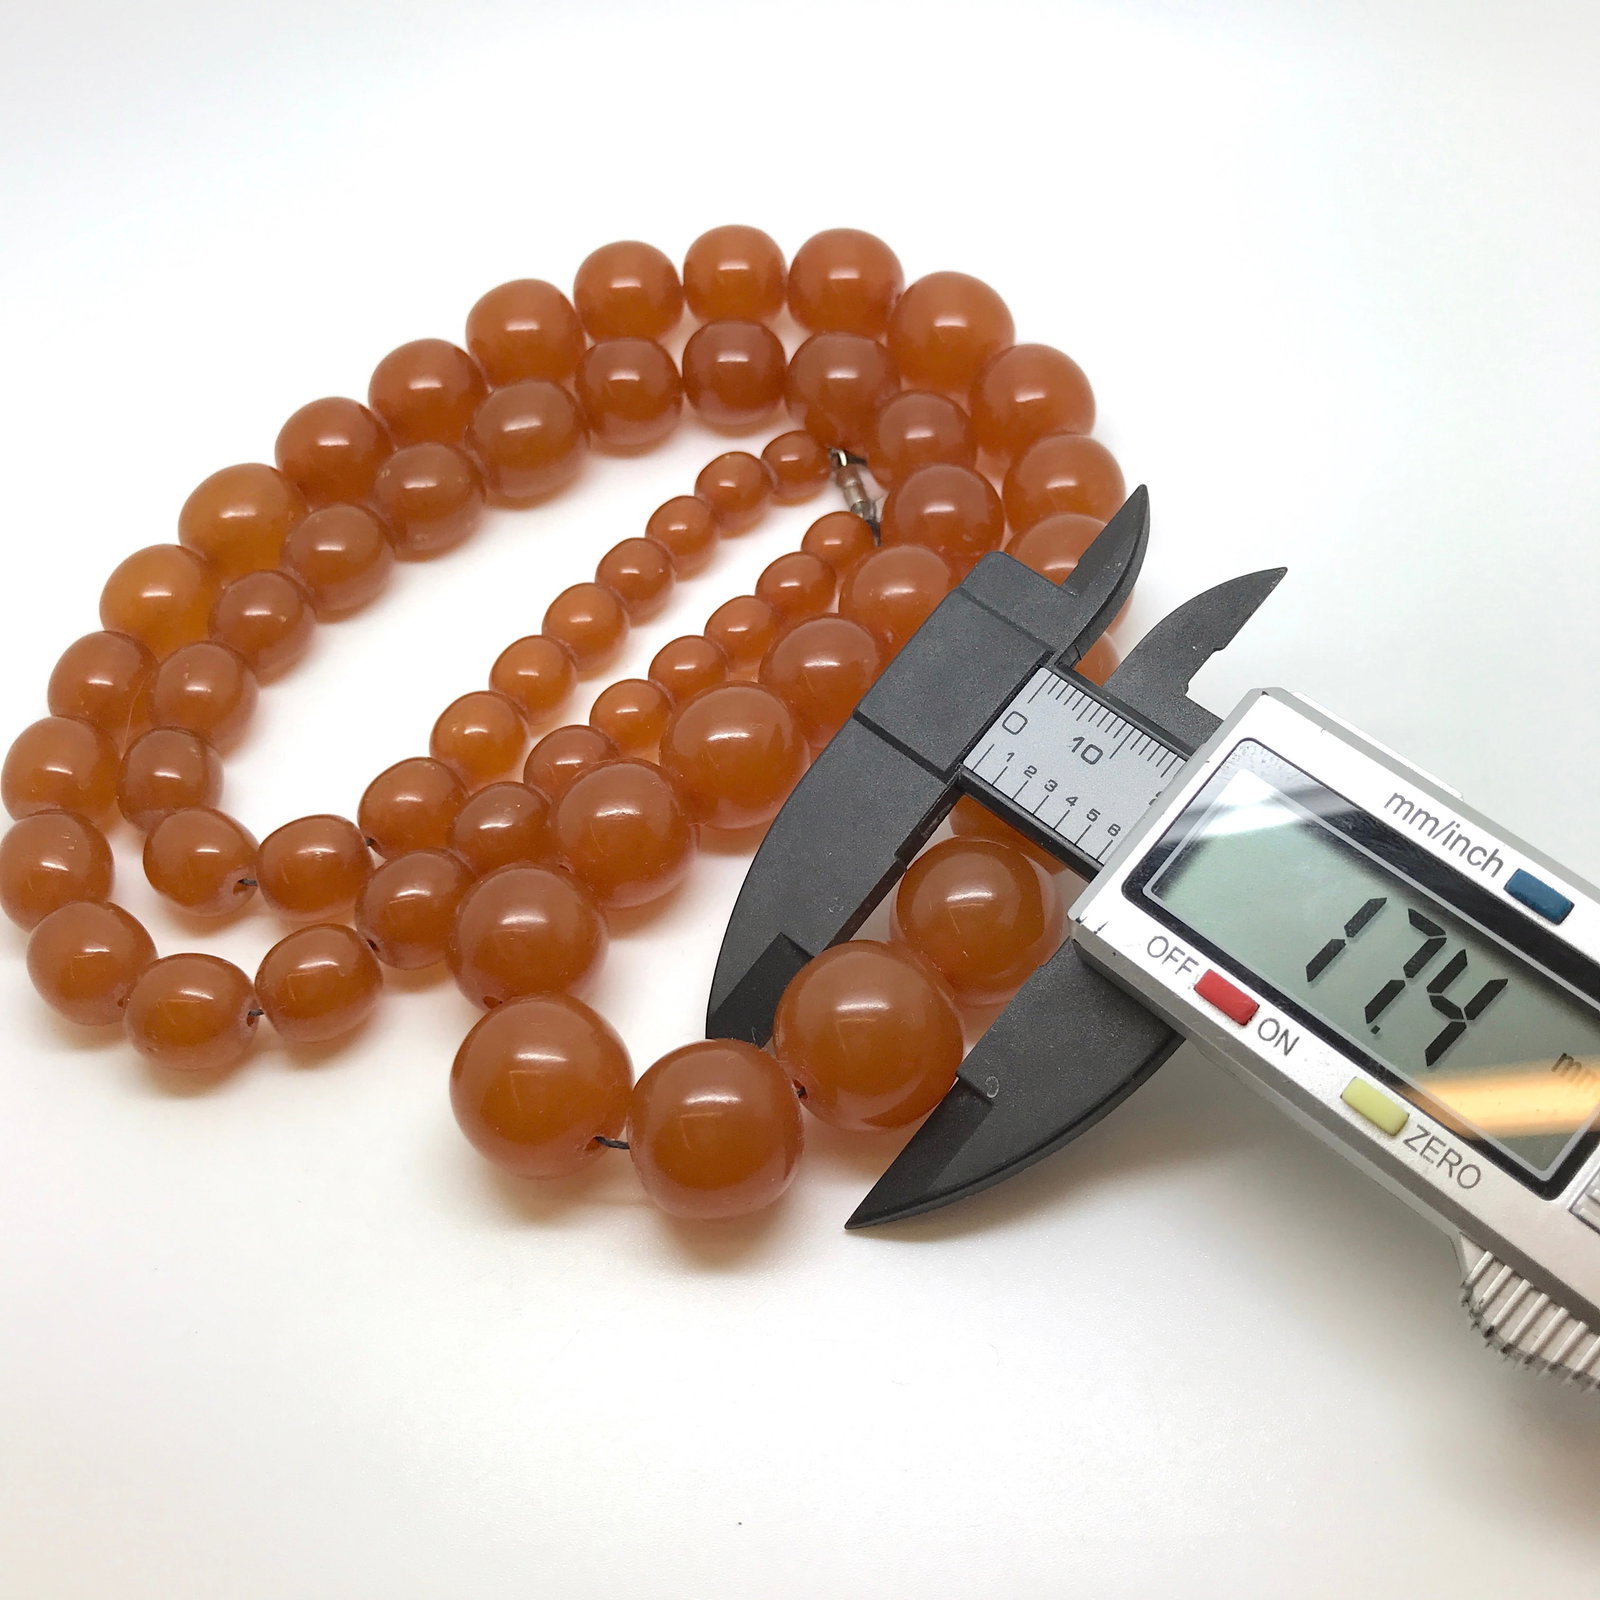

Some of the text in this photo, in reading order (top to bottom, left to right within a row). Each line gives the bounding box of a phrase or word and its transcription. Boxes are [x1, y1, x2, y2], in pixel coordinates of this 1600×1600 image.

[1002, 711, 1104, 765] 0 10
[1007, 752, 1122, 837] 1 2 3 4 5 6
[1384, 790, 1506, 880] mm/inch
[1146, 934, 1200, 978] OFF
[1305, 897, 1508, 1067] 17.4
[1257, 1017, 1301, 1057] ON
[1402, 1124, 1482, 1191] ZERO
